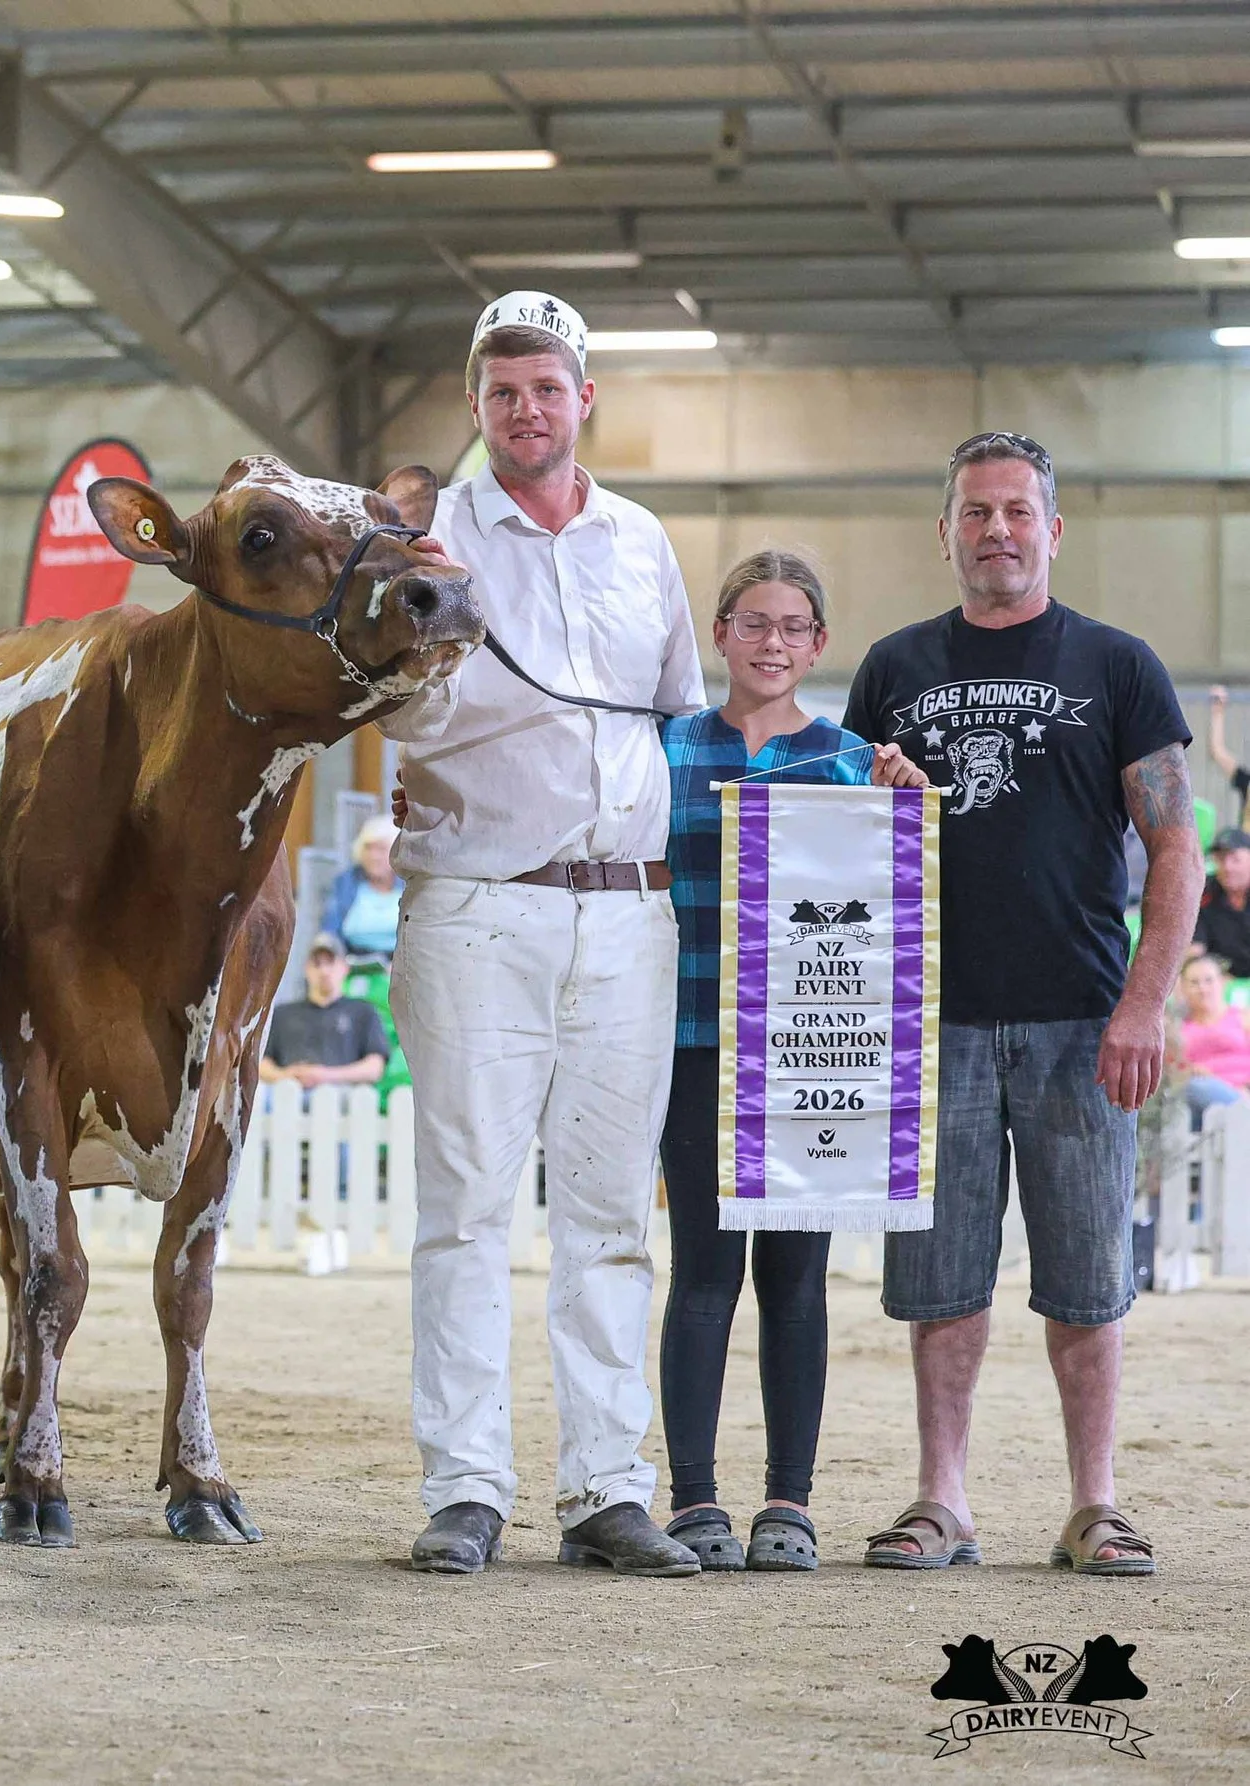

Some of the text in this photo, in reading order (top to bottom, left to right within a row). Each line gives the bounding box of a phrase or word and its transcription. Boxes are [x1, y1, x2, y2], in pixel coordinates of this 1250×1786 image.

[922, 684, 1053, 716] GAS MONKEY
[951, 712, 1018, 727] GARAGE
[1023, 748, 1046, 756] TEXAS
[816, 942, 845, 957] NZ
[797, 961, 864, 976] DAIRY
[794, 980, 866, 995] EVENT
[792, 1013, 866, 1027] GRAND
[771, 1031, 887, 1048] CHAMPION
[777, 1051, 881, 1068] AYRSHIRE
[793, 1088, 864, 1111] 2026
[807, 1147, 847, 1159] Vytelle
